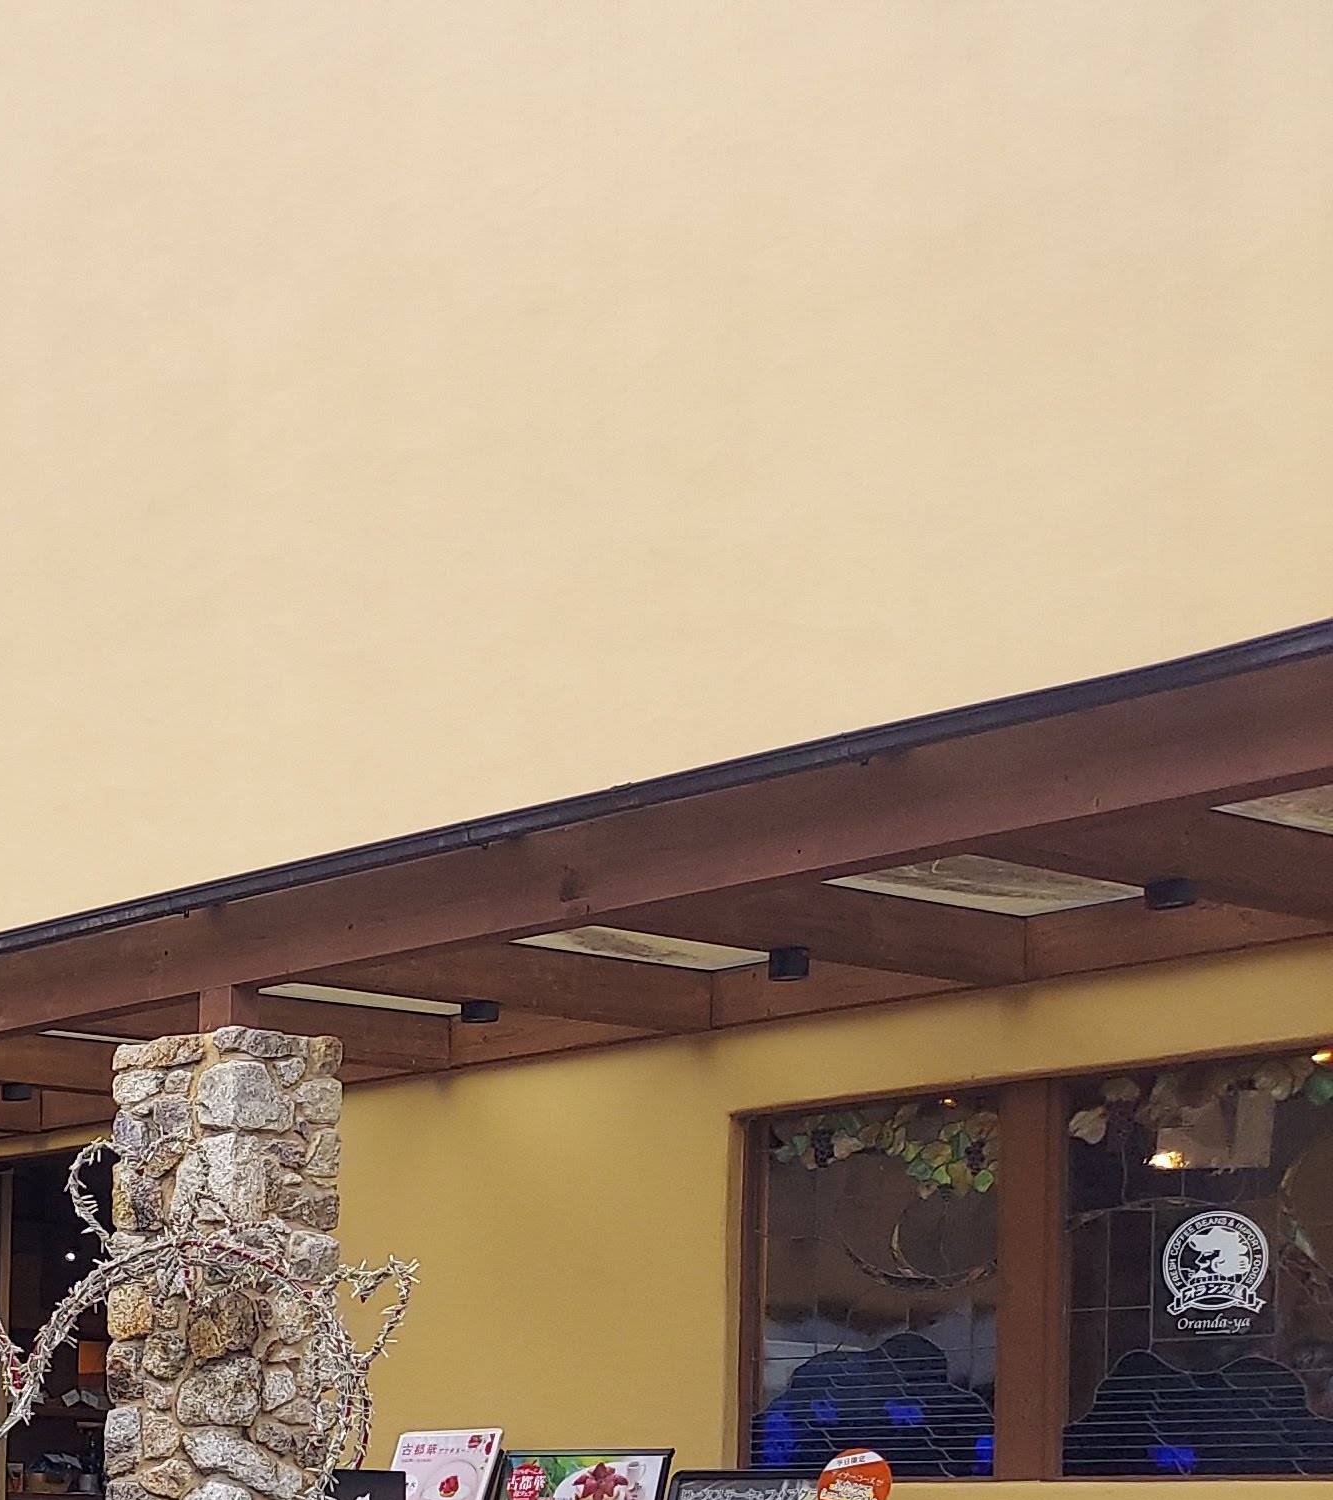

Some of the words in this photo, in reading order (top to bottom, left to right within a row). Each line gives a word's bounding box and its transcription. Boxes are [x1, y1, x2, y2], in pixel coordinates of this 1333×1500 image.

[1195, 1217, 1227, 1230] BEANS
[1235, 1222, 1262, 1251] IMPORT
[1171, 1225, 1196, 1256] COFFEE
[1168, 1258, 1182, 1287] FRESH
[1245, 1253, 1263, 1285] FOODS
[1177, 1313, 1251, 1334] Oranda-ya
